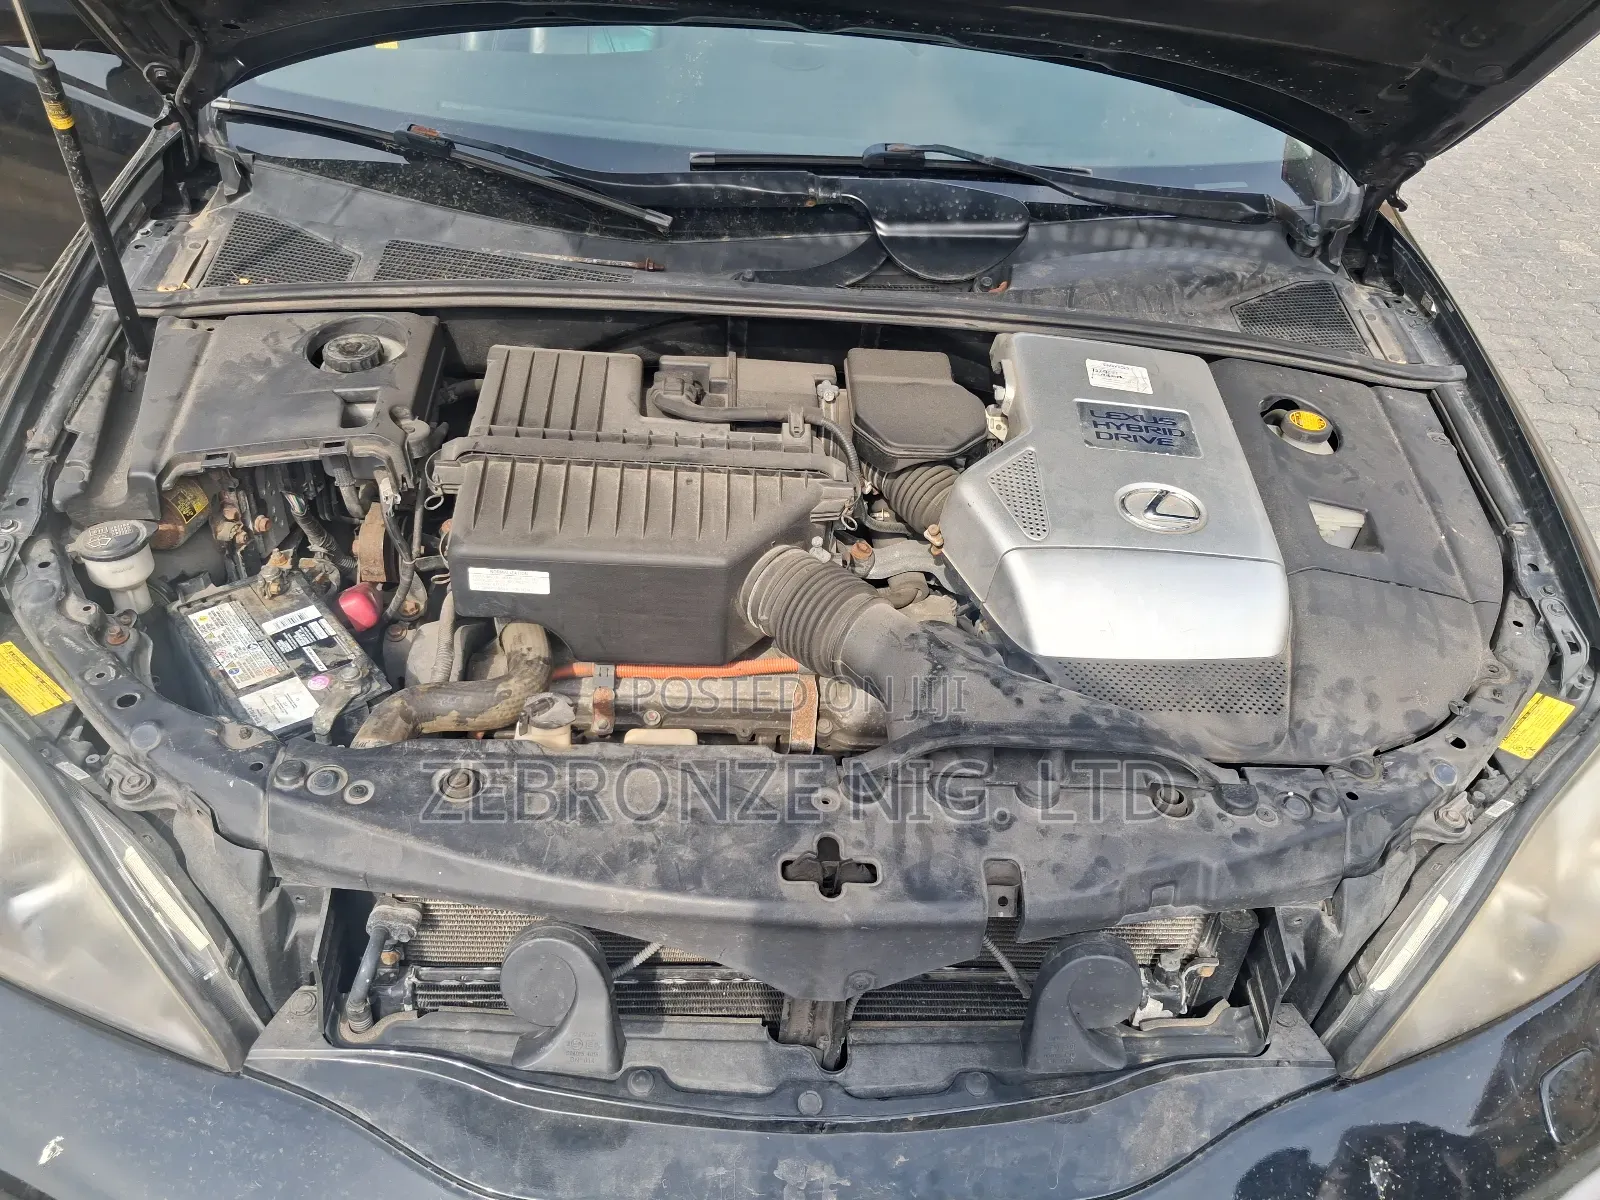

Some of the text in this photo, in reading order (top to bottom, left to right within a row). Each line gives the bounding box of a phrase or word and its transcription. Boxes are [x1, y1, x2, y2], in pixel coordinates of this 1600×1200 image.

[1089, 409, 1177, 426] LEXUS
[1092, 420, 1186, 437] HYBRID
[1095, 431, 1175, 447] DRIVE
